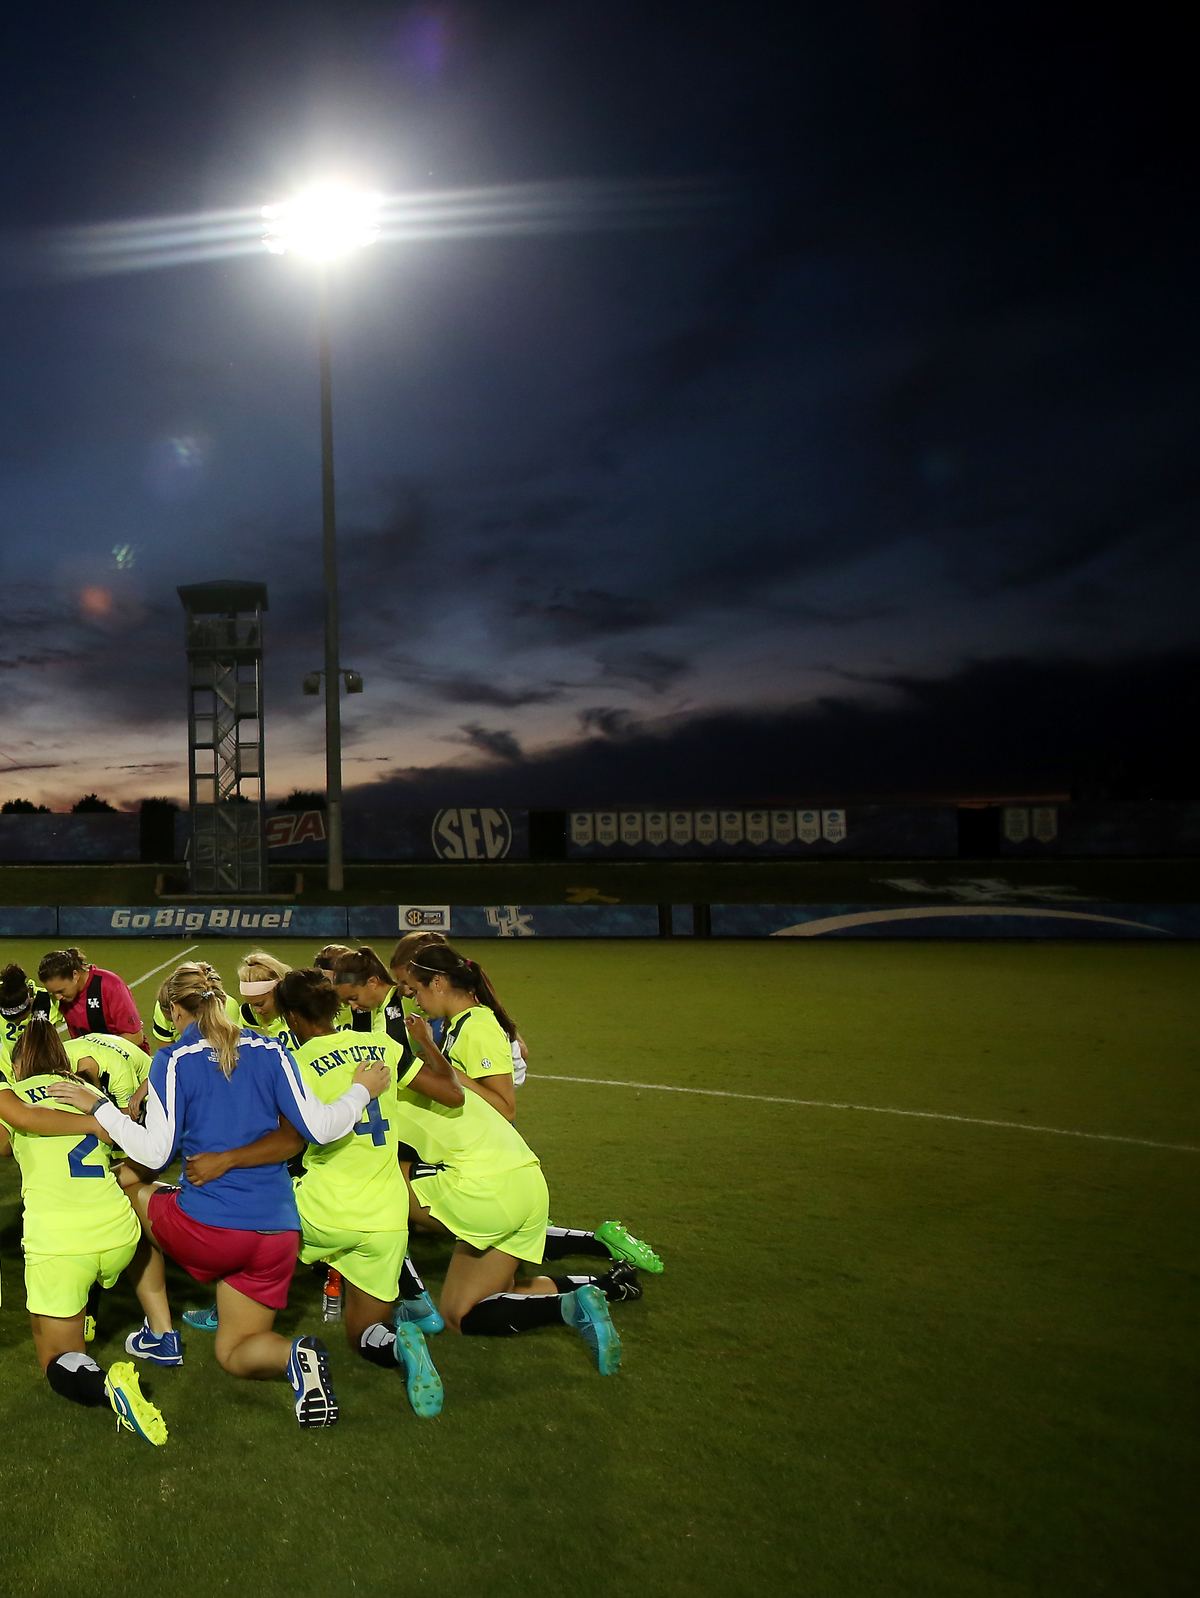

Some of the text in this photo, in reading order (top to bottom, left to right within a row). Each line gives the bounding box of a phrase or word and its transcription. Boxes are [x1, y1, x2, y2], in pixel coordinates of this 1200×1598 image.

[437, 808, 506, 859] SEC
[110, 908, 293, 931] Go Big Blue!
[407, 910, 423, 926] SEC
[310, 1045, 386, 1077] KENTUCKY
[352, 1096, 390, 1147] 4
[67, 1133, 106, 1179] 2
